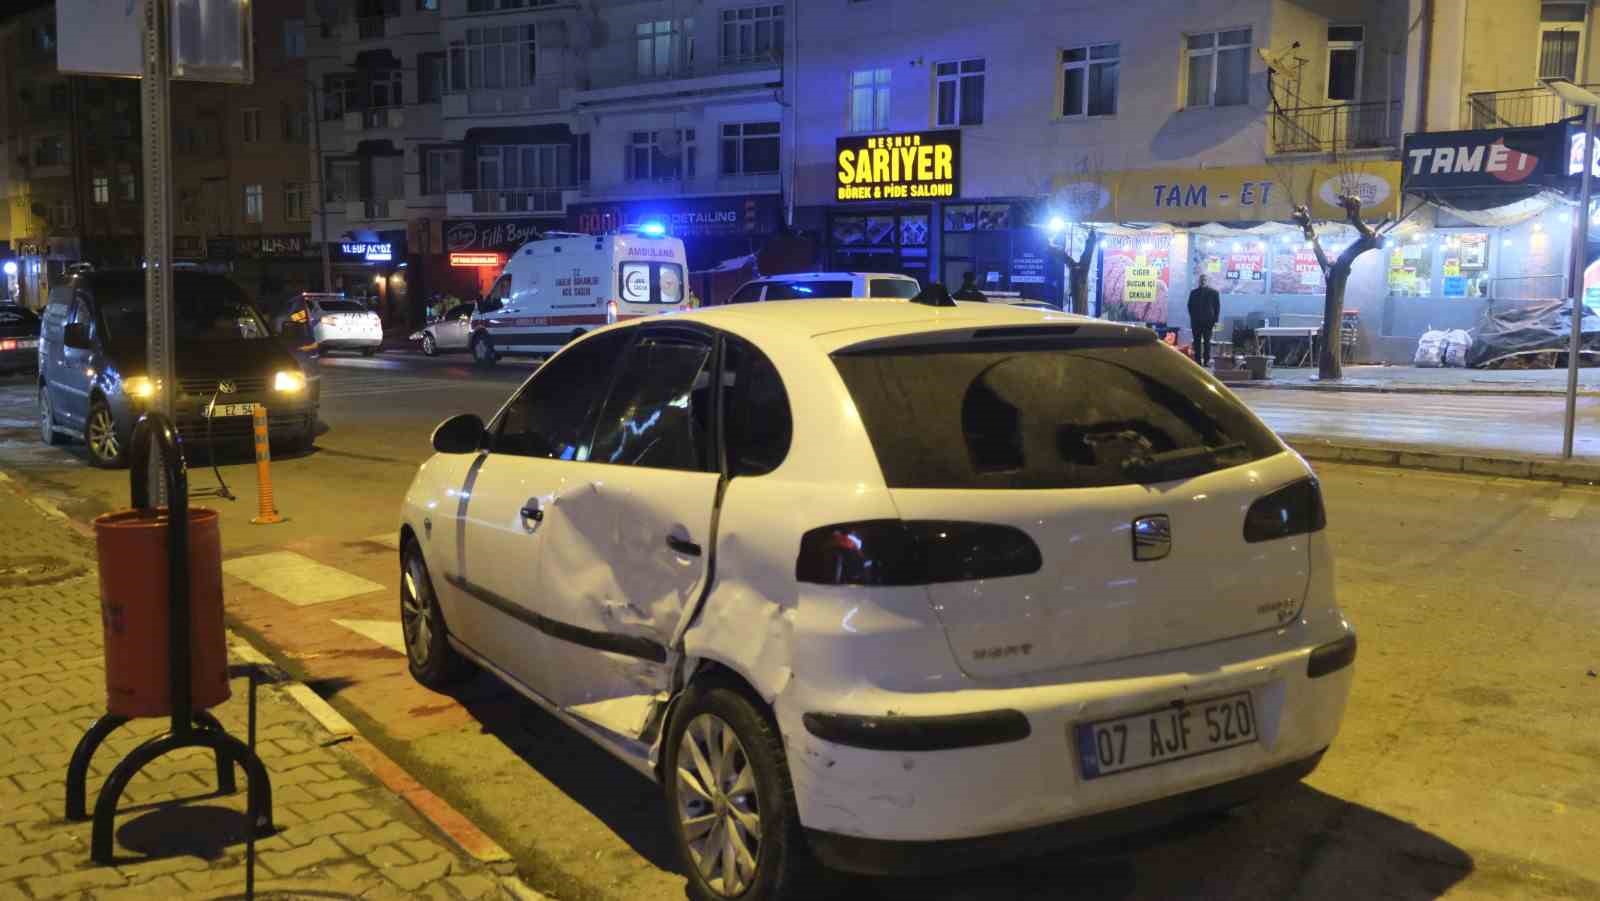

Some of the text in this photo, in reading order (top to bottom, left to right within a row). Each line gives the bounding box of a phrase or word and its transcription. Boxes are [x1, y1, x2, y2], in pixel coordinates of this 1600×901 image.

[868, 135, 920, 150] MEŞHUR
[838, 144, 953, 184] SARIYER
[838, 183, 953, 199] BÖREK & PİDE SALONU
[1153, 184, 1208, 208] TAM
[1241, 182, 1273, 205] ET
[1096, 701, 1251, 767] 07 AJF 520
